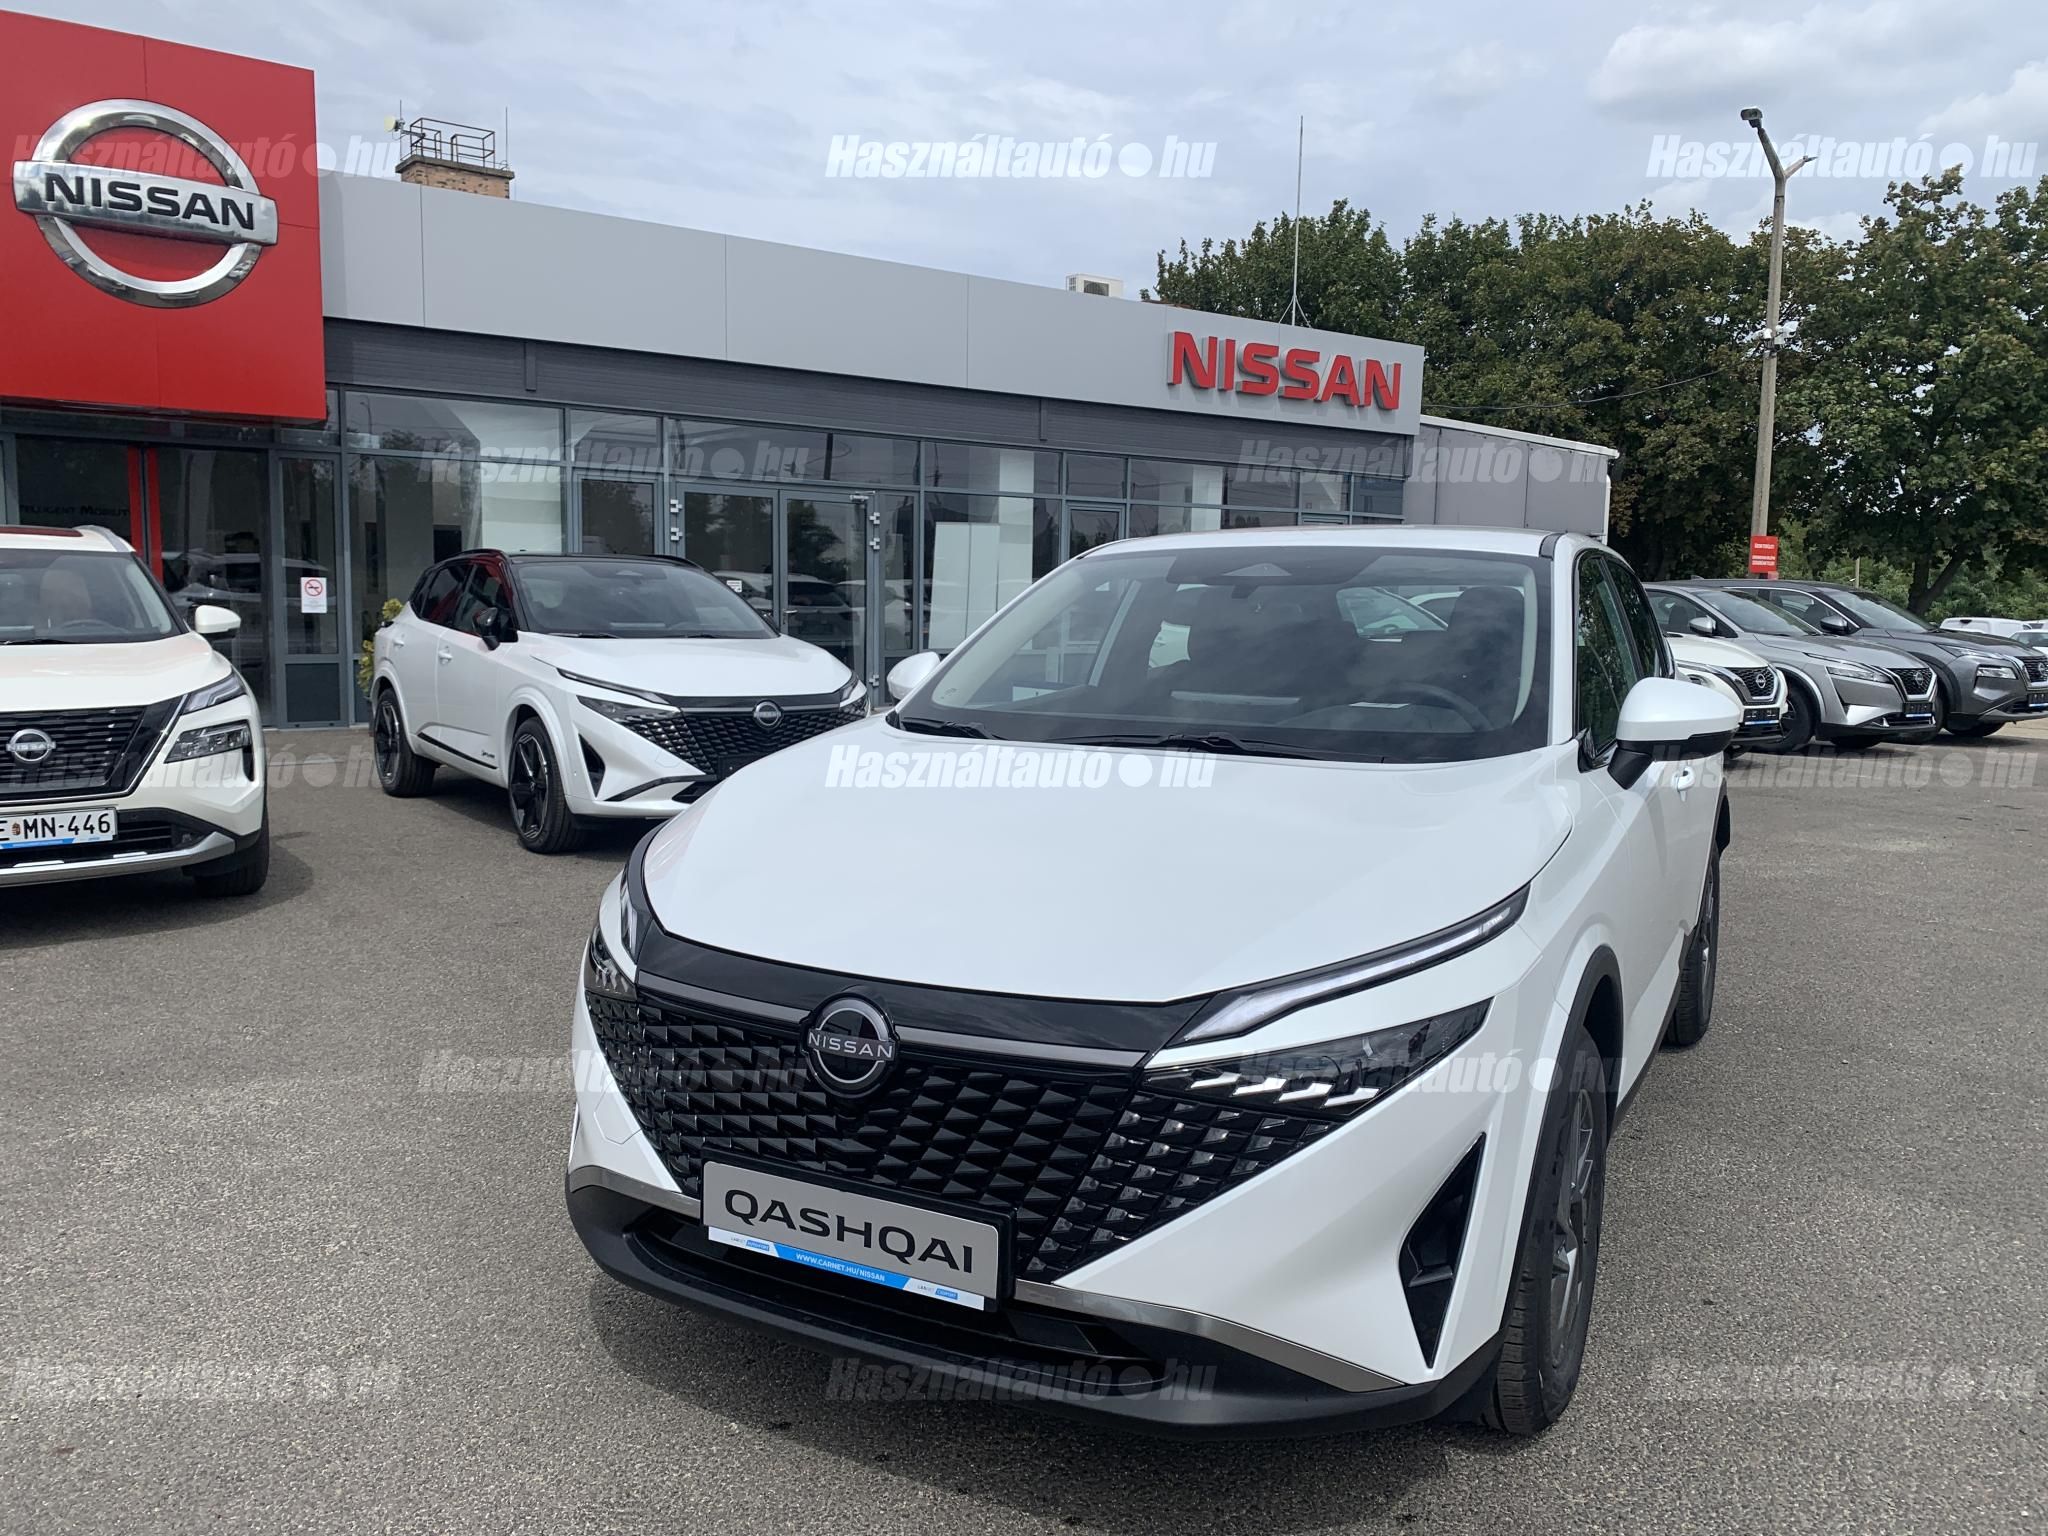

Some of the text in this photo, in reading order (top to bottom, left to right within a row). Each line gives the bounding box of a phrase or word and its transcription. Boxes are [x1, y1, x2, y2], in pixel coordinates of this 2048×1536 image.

[45, 172, 255, 230] NISSAN
[1168, 331, 1402, 410] NISSAN
[23, 812, 111, 840] MN-446
[808, 1032, 893, 1058] NISSAN
[724, 1189, 973, 1274] QASHQAI
